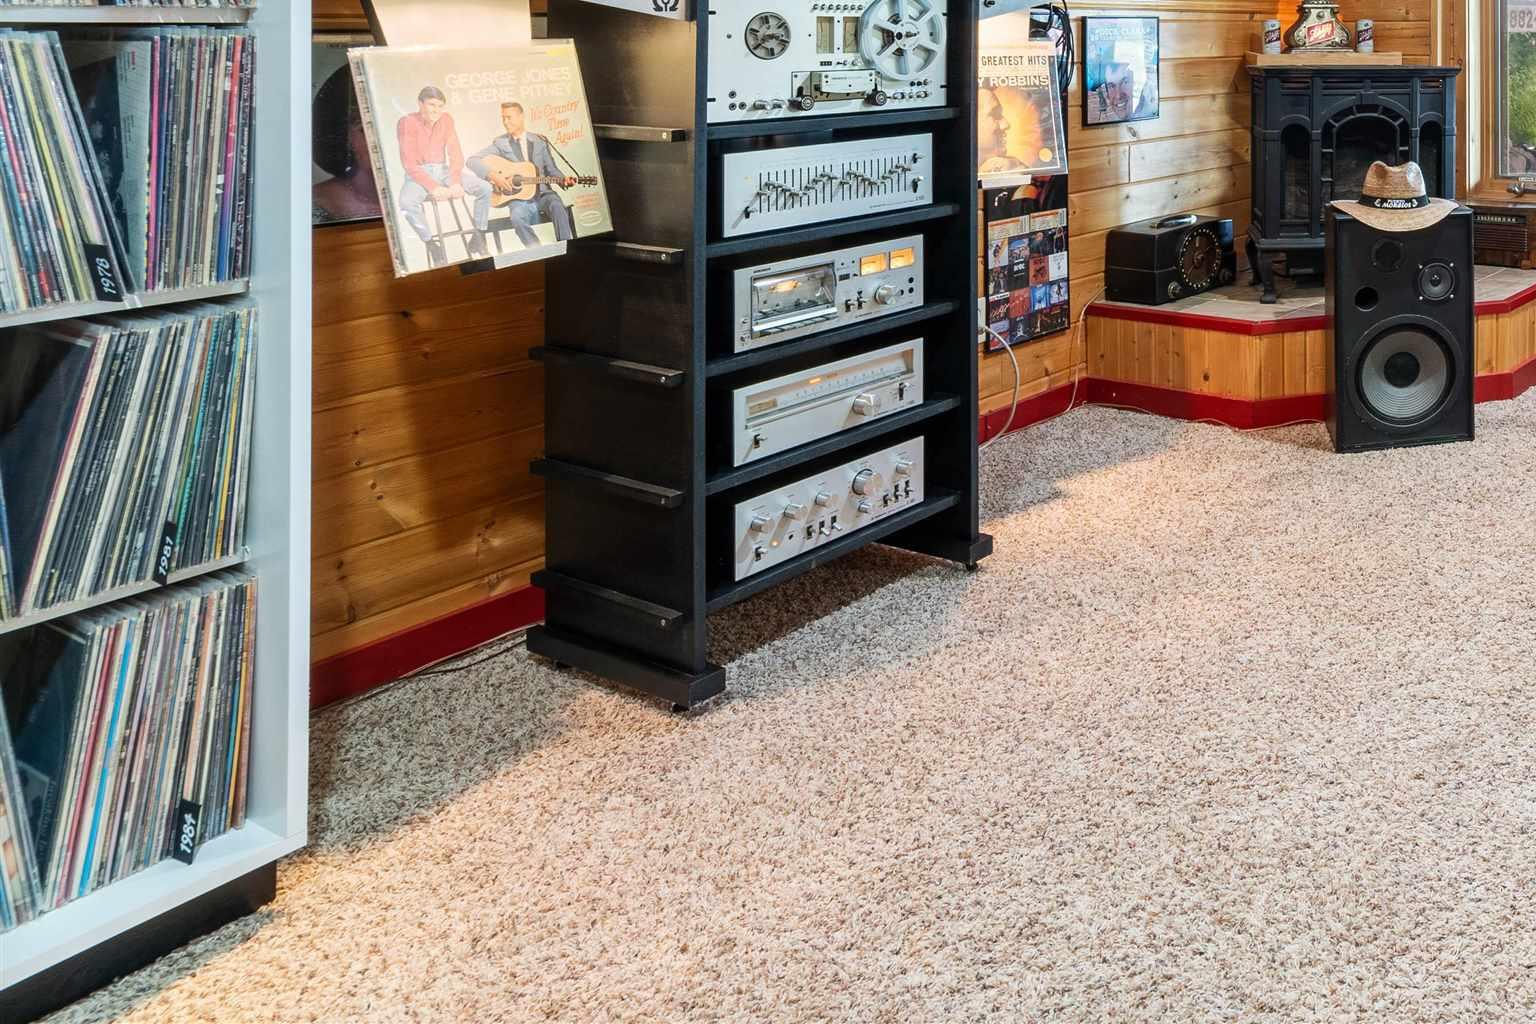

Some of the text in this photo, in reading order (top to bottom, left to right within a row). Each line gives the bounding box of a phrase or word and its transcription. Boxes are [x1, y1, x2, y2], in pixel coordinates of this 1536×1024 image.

[980, 54, 1048, 67] GREATEST HITS
[446, 66, 570, 89] GEORGE JONES
[989, 73, 1050, 88] ROBBINS
[471, 87, 514, 103] GENE
[519, 84, 572, 98] PITNEY
[543, 99, 579, 116] Country
[158, 535, 173, 577] 1981
[179, 811, 197, 854] 1984
